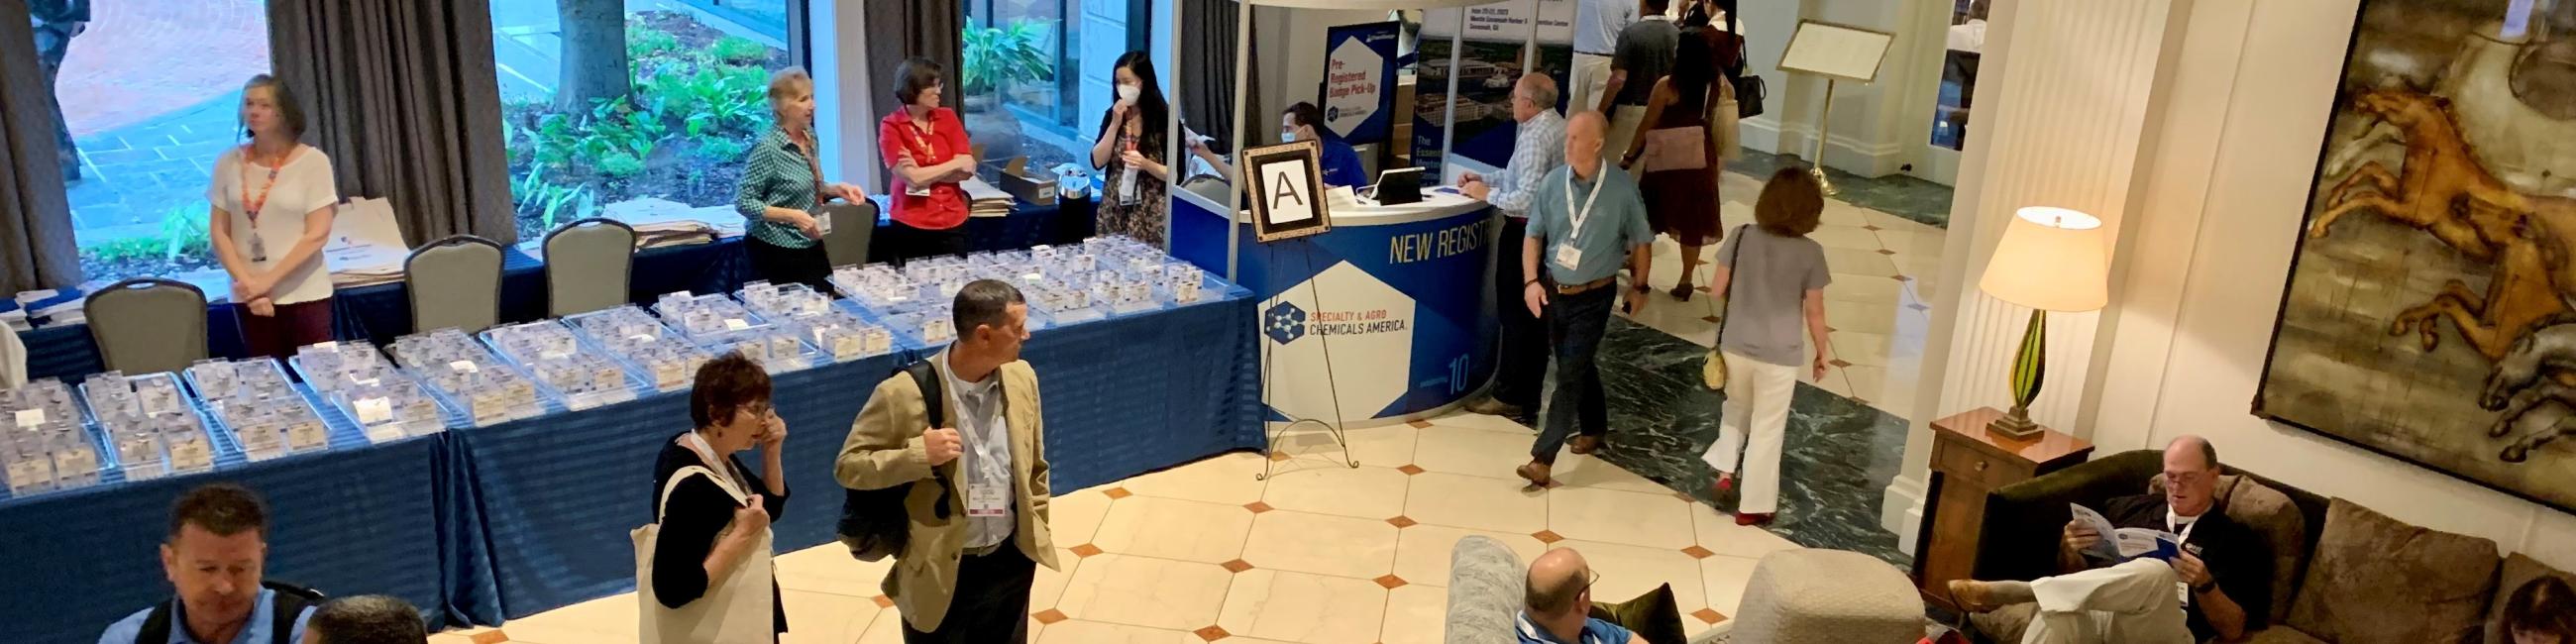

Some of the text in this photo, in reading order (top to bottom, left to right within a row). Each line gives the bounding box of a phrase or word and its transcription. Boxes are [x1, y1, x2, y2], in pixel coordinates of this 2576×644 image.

[1331, 59, 1345, 70] Pre-
[1331, 69, 1366, 85] Registered
[1350, 81, 1376, 96] Pick-Up
[1418, 135, 1431, 146] The
[1273, 171, 1303, 209] A
[1389, 232, 1433, 265] NEW
[1310, 309, 1387, 322] SPECIALTY & AGRO
[1310, 323, 1364, 336] CHEMICALS
[1449, 353, 1469, 395] 10
